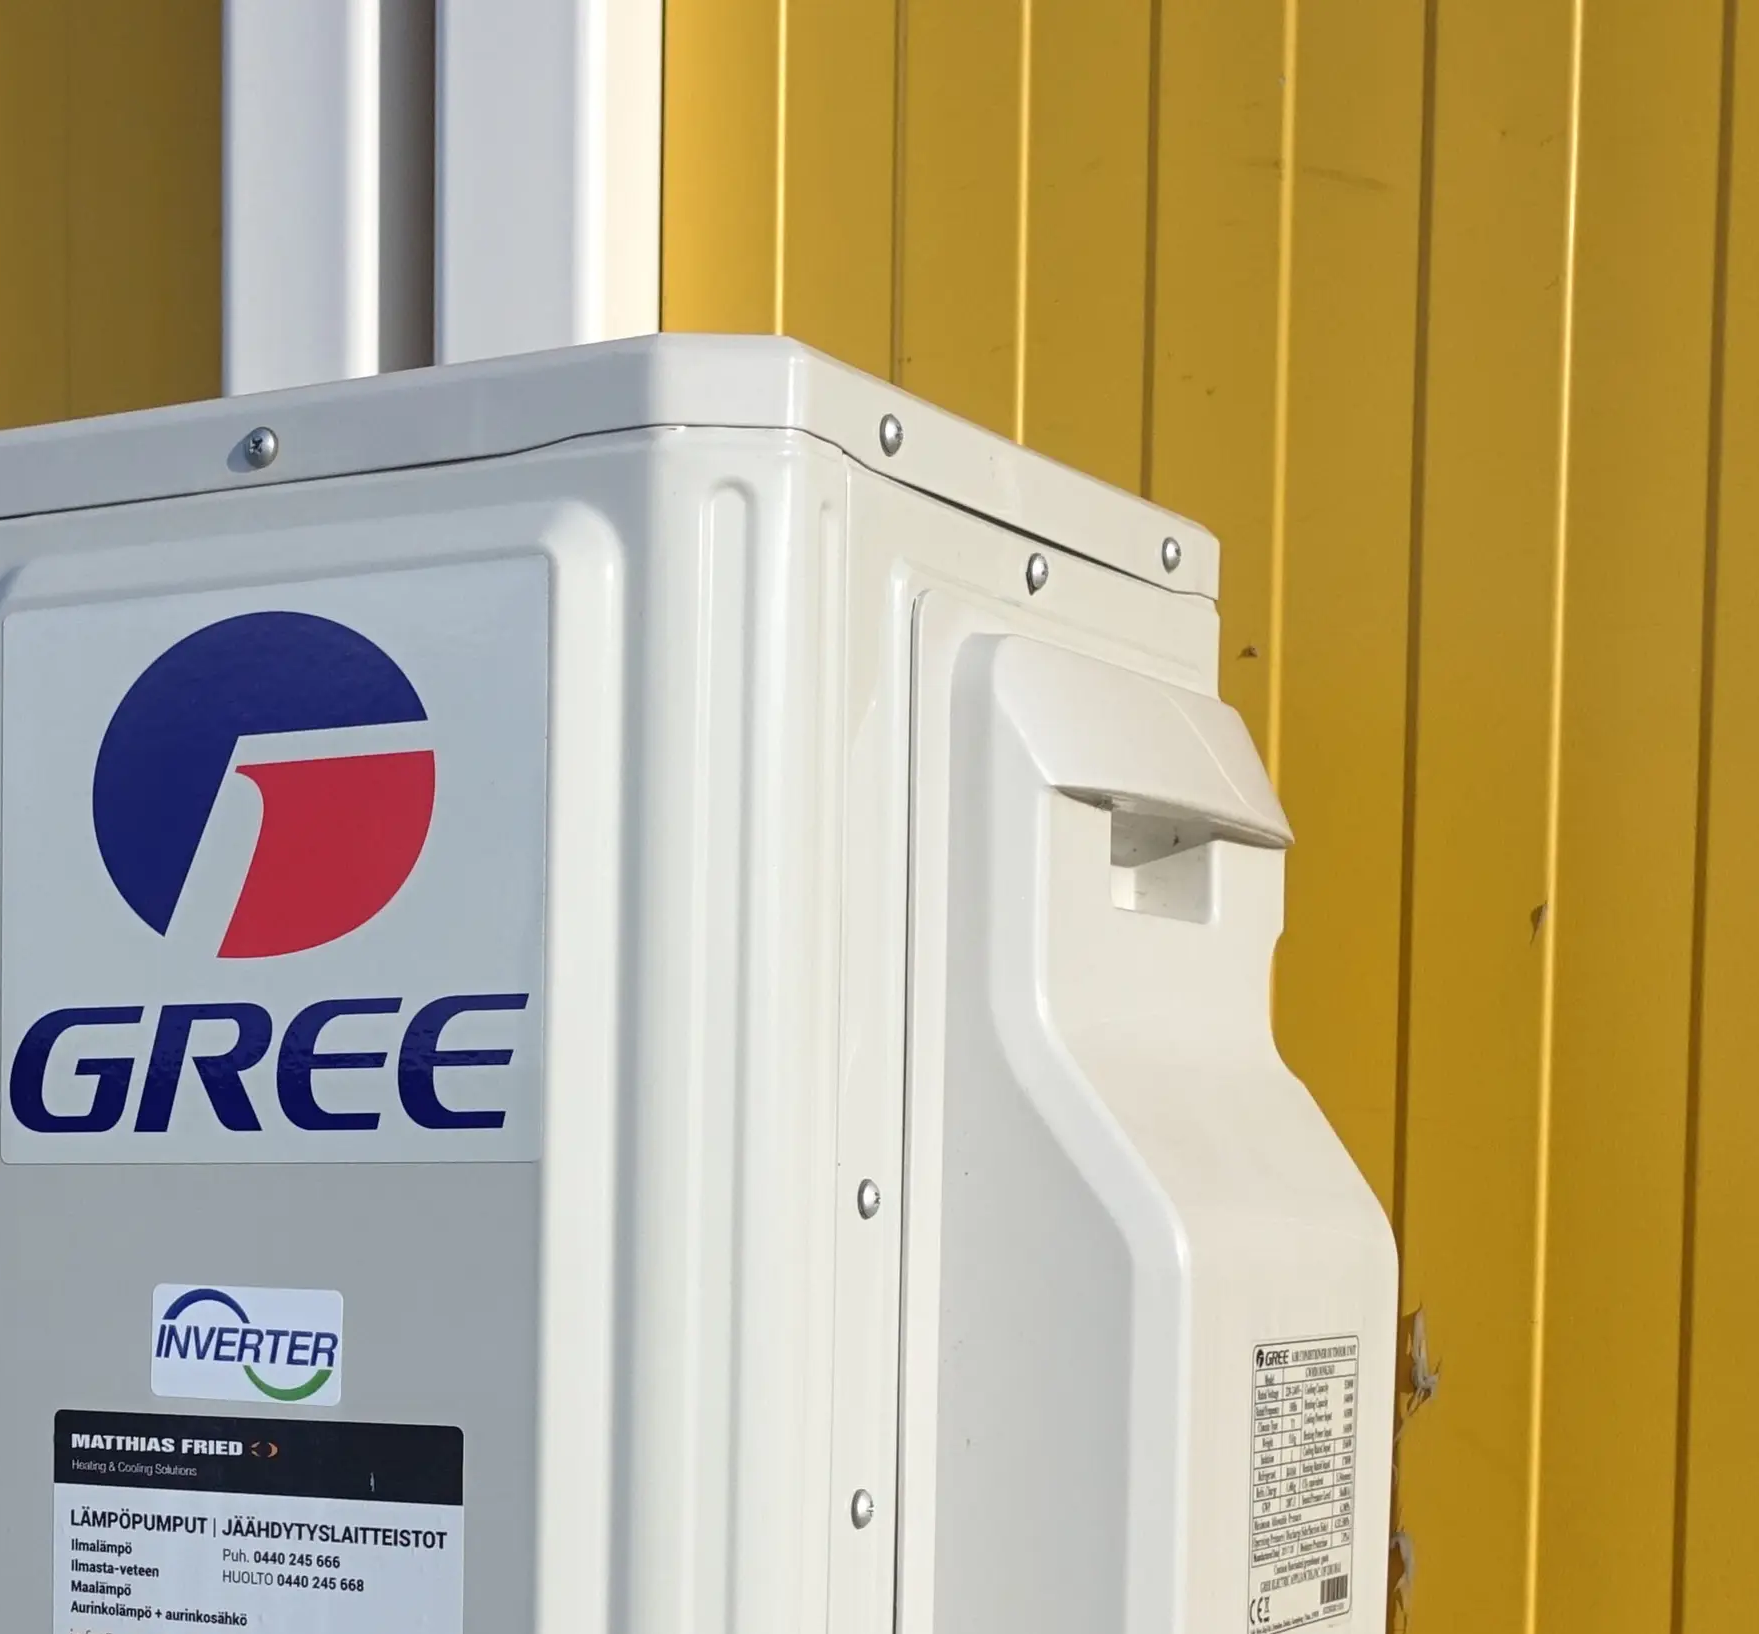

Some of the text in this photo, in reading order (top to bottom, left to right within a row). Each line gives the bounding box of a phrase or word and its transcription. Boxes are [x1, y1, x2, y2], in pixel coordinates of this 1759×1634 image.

[9, 993, 529, 1133] GREE
[155, 1324, 338, 1367] INVERTER
[1265, 1349, 1289, 1366] GREE
[71, 1433, 243, 1456] MATTHIAS FRIED
[72, 1459, 197, 1477] Heating & Cooling Solutions
[70, 1506, 208, 1534] LÄMPÖPUMPUT
[222, 1515, 448, 1550] JÄÄHDYTYSLAITTEISTOT
[71, 1538, 133, 1557] Ilmalämpö
[71, 1559, 160, 1578] Ilmasta-veteen
[222, 1549, 341, 1569] Puh. 0440 245 666
[71, 1580, 132, 1599] Maalämpö
[222, 1570, 365, 1592] HUOLTO 0440 245 668
[70, 1600, 152, 1620] Aurinkolämpö
[165, 1609, 248, 1626] aurinkosähkö
